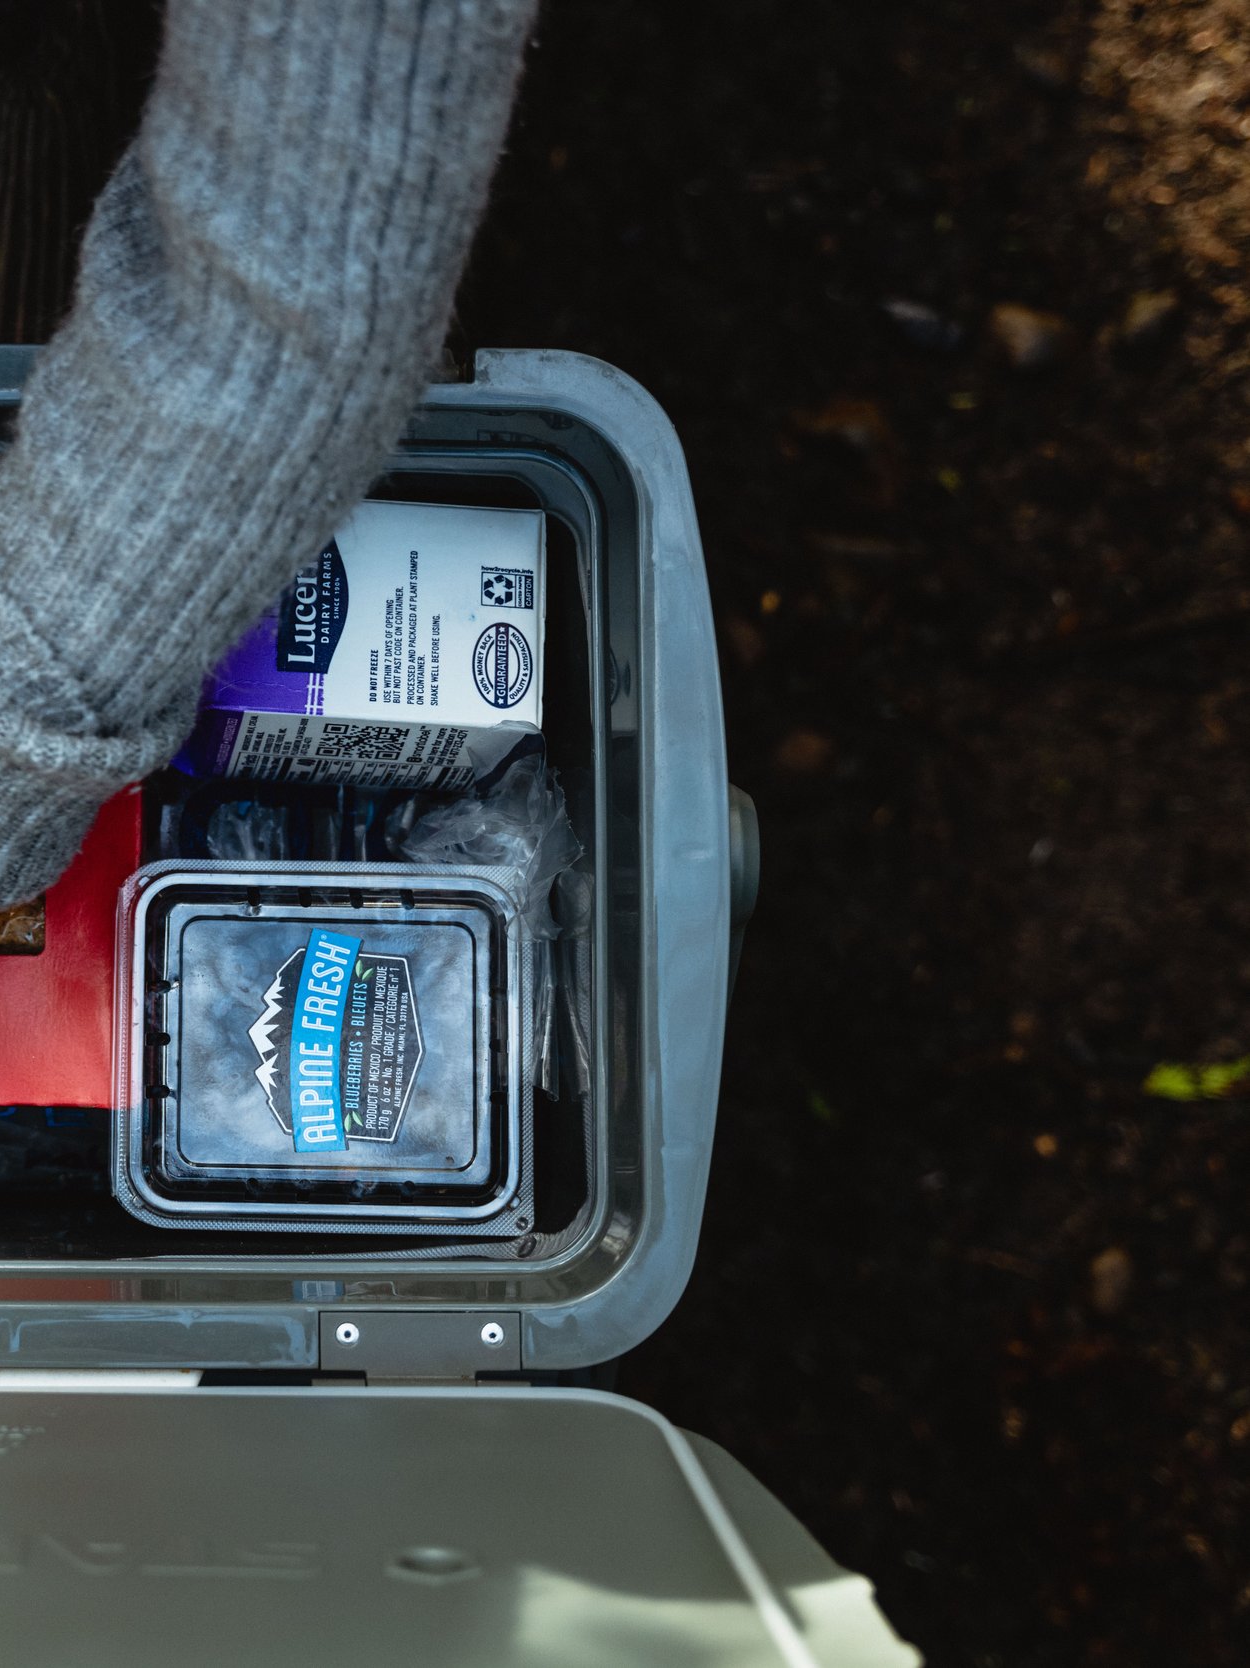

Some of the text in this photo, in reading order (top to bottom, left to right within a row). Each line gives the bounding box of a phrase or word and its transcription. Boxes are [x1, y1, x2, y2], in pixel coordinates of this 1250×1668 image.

[410, 551, 418, 580] STAMPED
[321, 552, 332, 643] DAIRY FARMS
[395, 586, 404, 625] CONTAINER.
[288, 562, 318, 663] Lucer
[432, 614, 440, 636] USING.
[386, 630, 393, 638] OF
[395, 627, 403, 636] ON
[409, 613, 417, 648] PACKAGED
[480, 634, 493, 650] BACK
[385, 640, 393, 657] DAYS
[431, 638, 439, 663] BEFORE
[511, 632, 528, 671] SATISFACTION
[369, 650, 378, 701] DO NOT FREEZE
[384, 665, 392, 688] WITHIN
[394, 658, 402, 674] PAST
[431, 666, 439, 682] WELL
[497, 633, 506, 697] GUARANTEED
[407, 665, 416, 704] PROCESSED
[417, 655, 425, 705] ON CONTAINER.
[479, 678, 491, 694] 100%
[509, 678, 527, 700] QUALITY
[393, 691, 401, 703] BUT
[376, 966, 387, 998] MEXIQUE
[376, 1000, 385, 1011] DU
[384, 985, 398, 1023] CATÉGORIE
[373, 1013, 384, 1045] PRODUIT
[345, 983, 368, 1108] BLUEBERRIES BLEUETS
[385, 1032, 395, 1056] GRADE
[394, 1087, 402, 1107] ALPINE
[400, 1005, 408, 1022] 33178
[369, 1054, 380, 1081] MEXICO
[384, 1066, 393, 1077] No.
[299, 1042, 337, 1143] ALPINE
[368, 1083, 379, 1093] OF
[383, 1088, 391, 1096] oz
[366, 1095, 379, 1129] PRODUCT
[379, 1117, 389, 1130] 170
